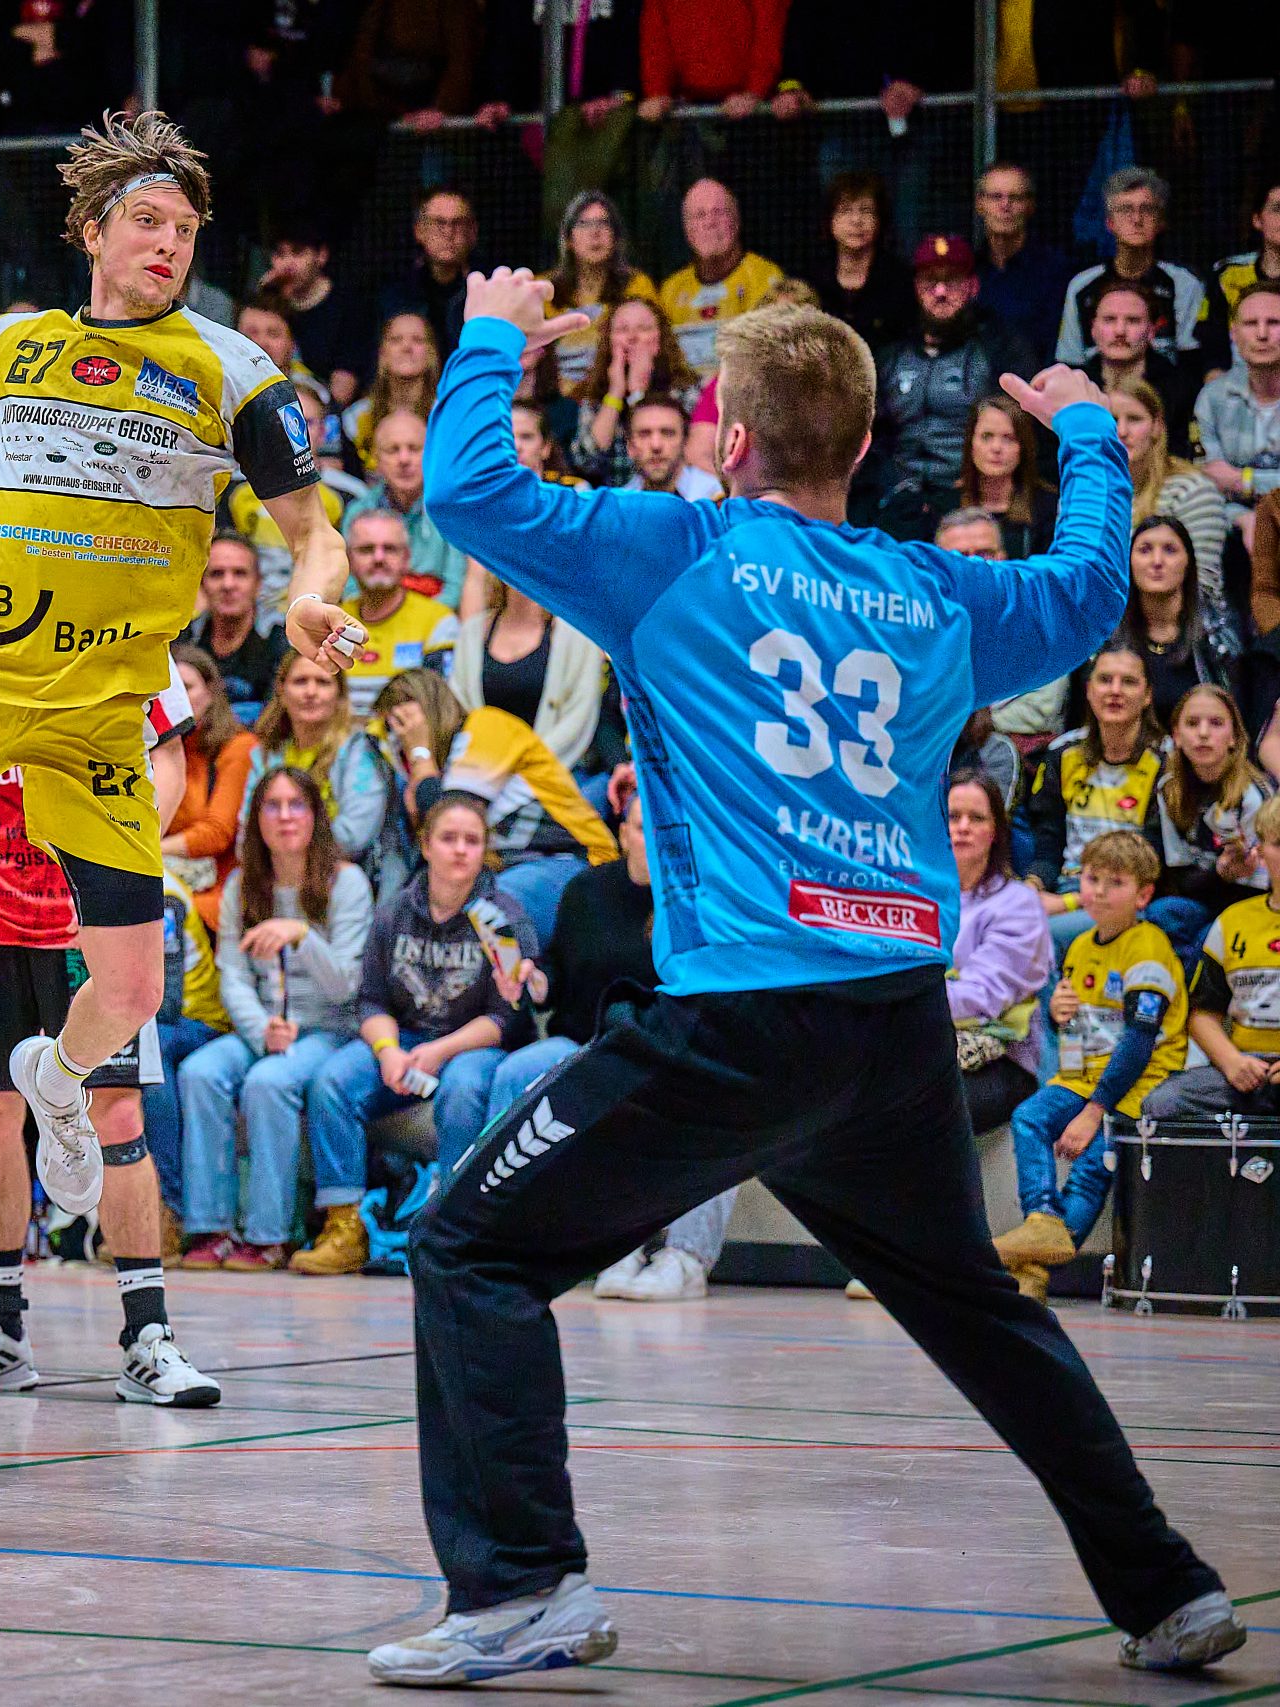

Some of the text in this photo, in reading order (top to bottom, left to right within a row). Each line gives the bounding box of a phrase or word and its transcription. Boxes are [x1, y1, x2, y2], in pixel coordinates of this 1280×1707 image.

[140, 175, 157, 185] NIKE
[4, 339, 67, 384] 27
[87, 366, 109, 377] TVK
[141, 384, 159, 394] 0721
[1, 404, 179, 450] AUTOHAUSGRUPPE GEISSER
[22, 473, 122, 494] WWW.AUTOHAUS-GEISSER.DE
[26, 545, 170, 567] Die besten Tarife zum besten Preis
[793, 571, 935, 630] RINTHEIM
[749, 628, 902, 798] 33
[88, 759, 141, 796] 27
[775, 805, 913, 869] AHRENS
[820, 897, 920, 931] BECKER
[1232, 932, 1247, 959] 4
